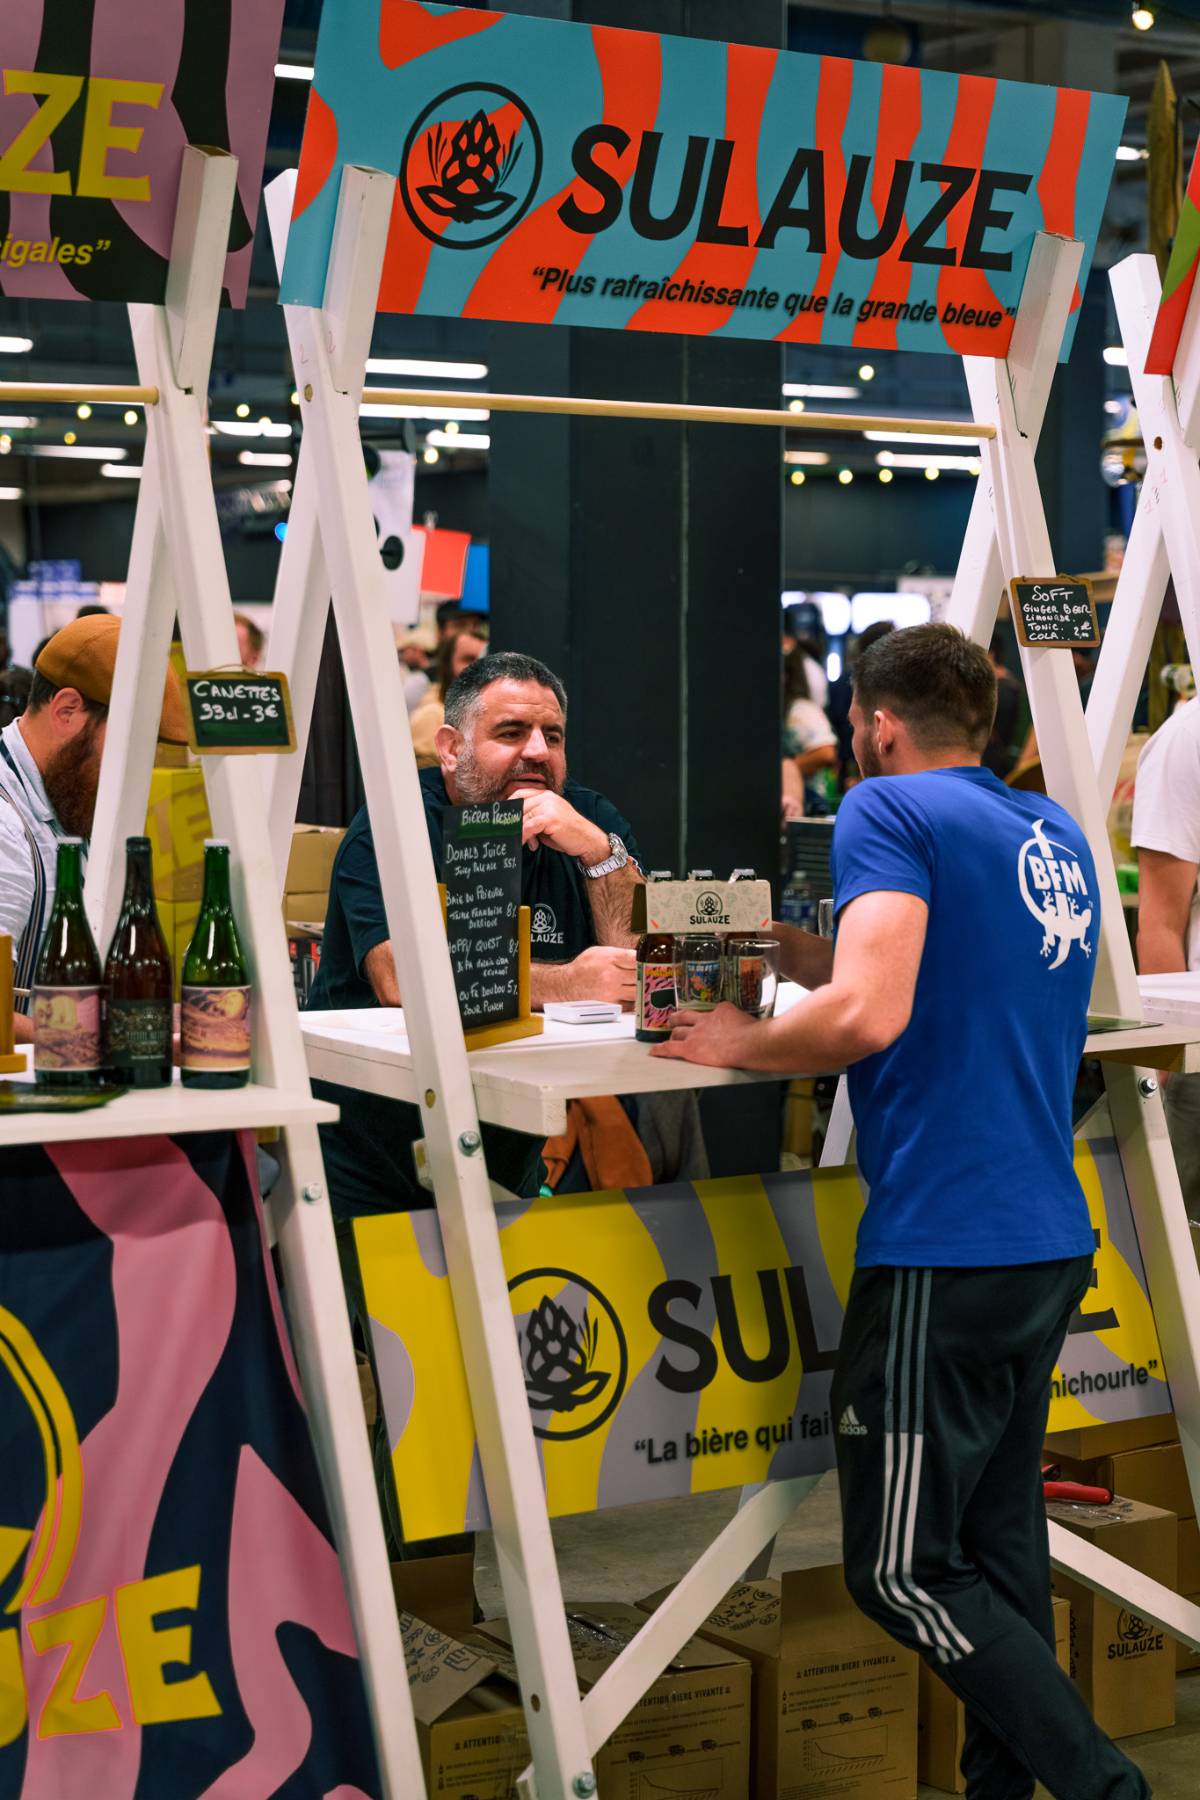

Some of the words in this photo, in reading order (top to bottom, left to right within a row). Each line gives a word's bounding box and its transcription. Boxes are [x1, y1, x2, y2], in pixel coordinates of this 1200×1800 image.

[556, 123, 1034, 273] SULAUZE
[0, 231, 112, 268] igales”
[532, 266, 597, 295] “Plus
[600, 273, 781, 309] rafraîchissante
[783, 291, 829, 316] que
[831, 292, 854, 316] la
[856, 298, 938, 323] grande
[941, 302, 1017, 329] bleue”
[1031, 585, 1075, 602] SOFT
[193, 680, 282, 702] CANETTES
[1027, 854, 1089, 896] BFM
[689, 914, 731, 925] SULAUZE
[530, 932, 565, 944] LAUZE
[633, 1437, 678, 1465] “La
[685, 1428, 749, 1458] bière
[755, 1416, 793, 1451] qui
[800, 1411, 835, 1440] fai
[1107, 1633, 1164, 1660] SULAUZE
